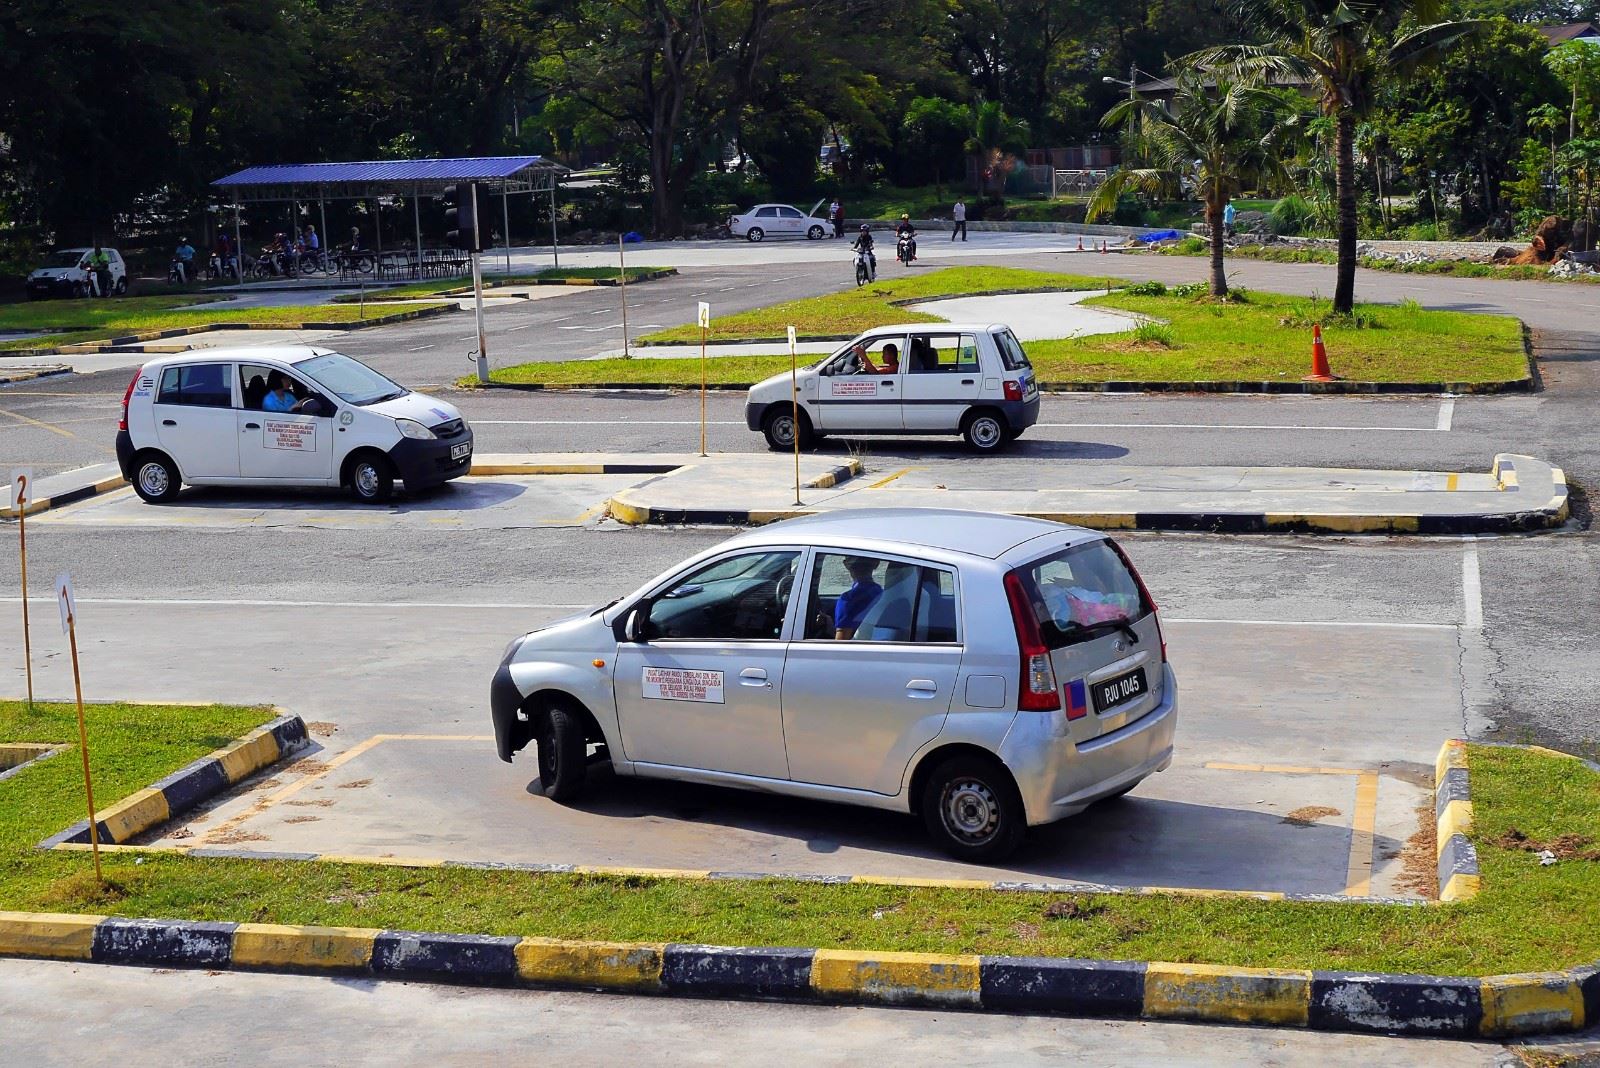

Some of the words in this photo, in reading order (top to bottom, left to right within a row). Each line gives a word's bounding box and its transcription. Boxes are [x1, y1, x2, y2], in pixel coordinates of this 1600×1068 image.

[17, 475, 27, 504] 2
[1104, 683, 1120, 704] PJU
[1120, 675, 1140, 697] 1045
